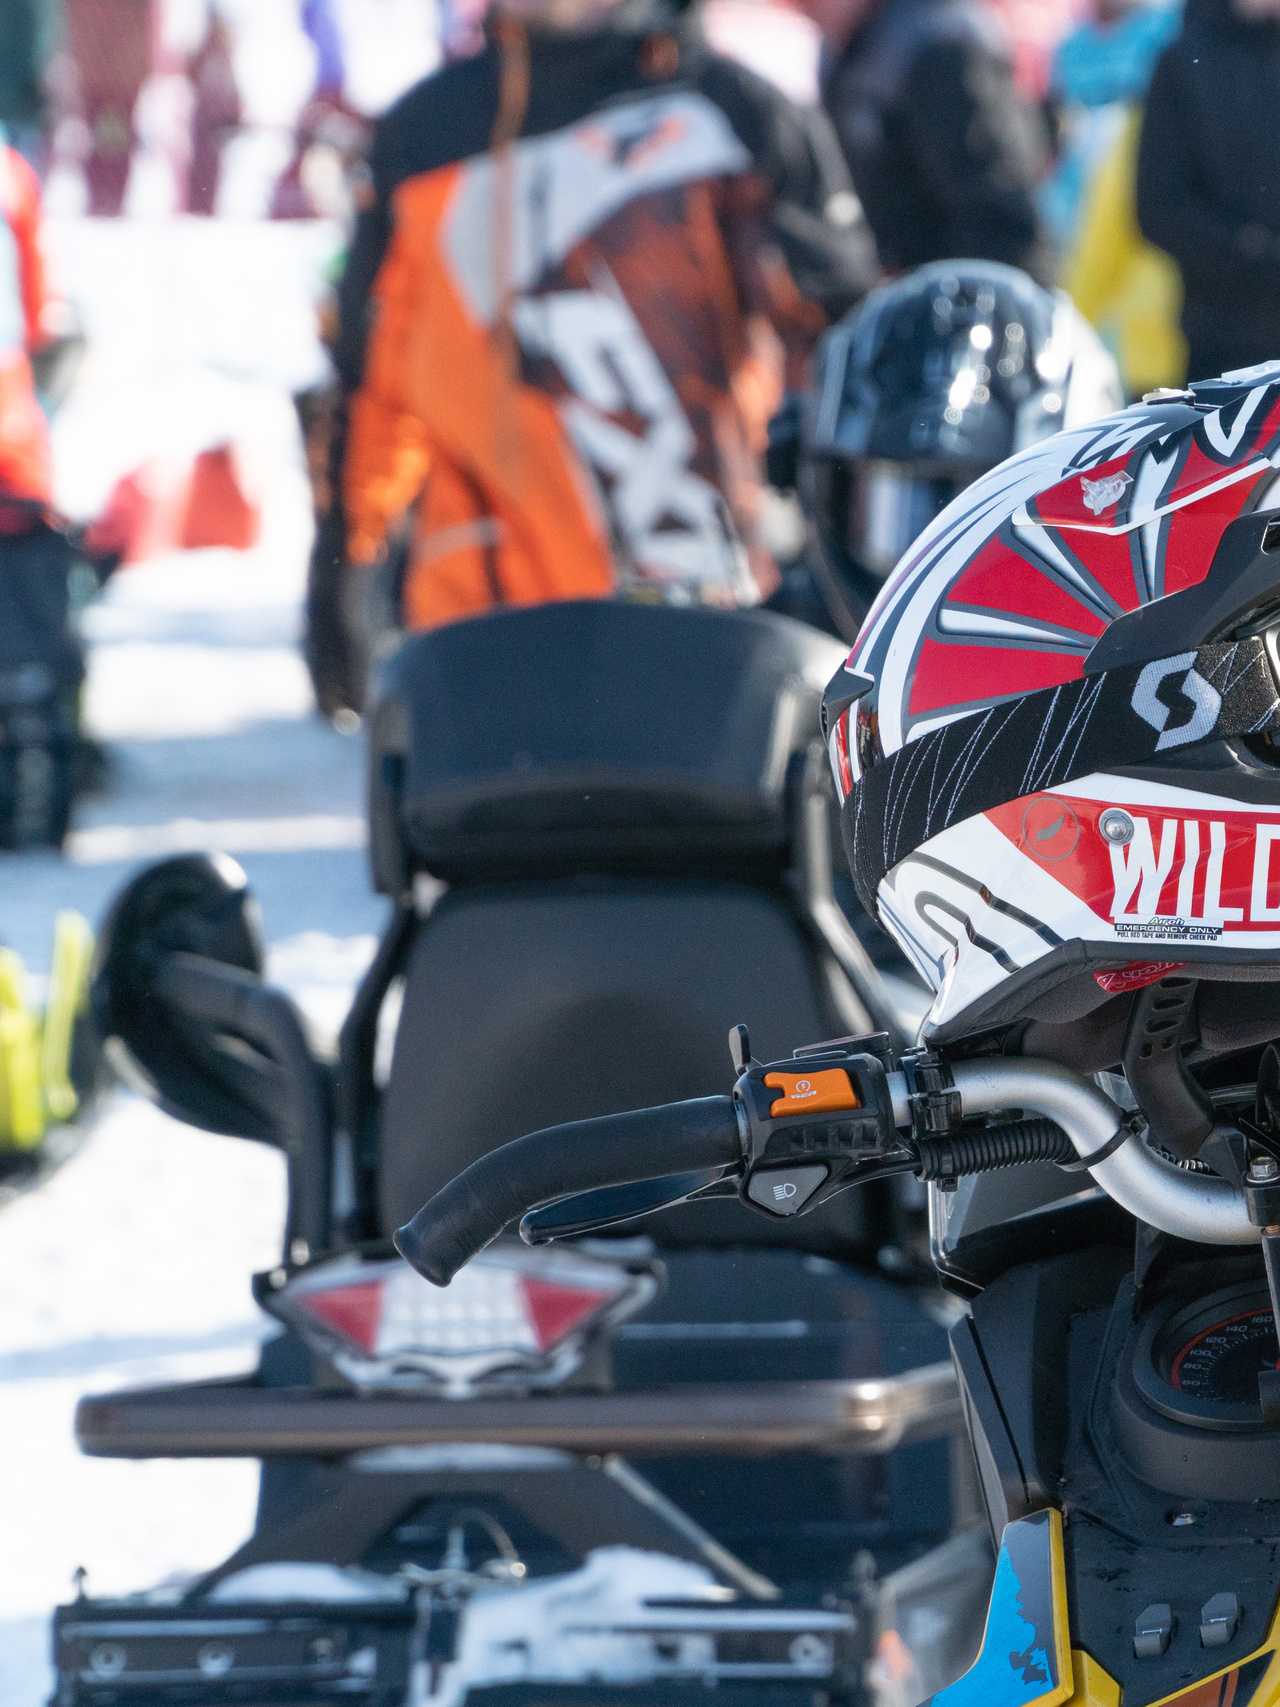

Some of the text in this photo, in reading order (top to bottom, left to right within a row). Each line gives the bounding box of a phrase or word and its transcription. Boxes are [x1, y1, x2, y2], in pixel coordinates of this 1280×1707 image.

[1148, 916, 1186, 926] Airoh
[1116, 925, 1219, 935] EMERGENCY ONLY
[1251, 1315, 1273, 1324] 160
[1225, 1325, 1248, 1333] 140
[1189, 1349, 1212, 1357] 100
